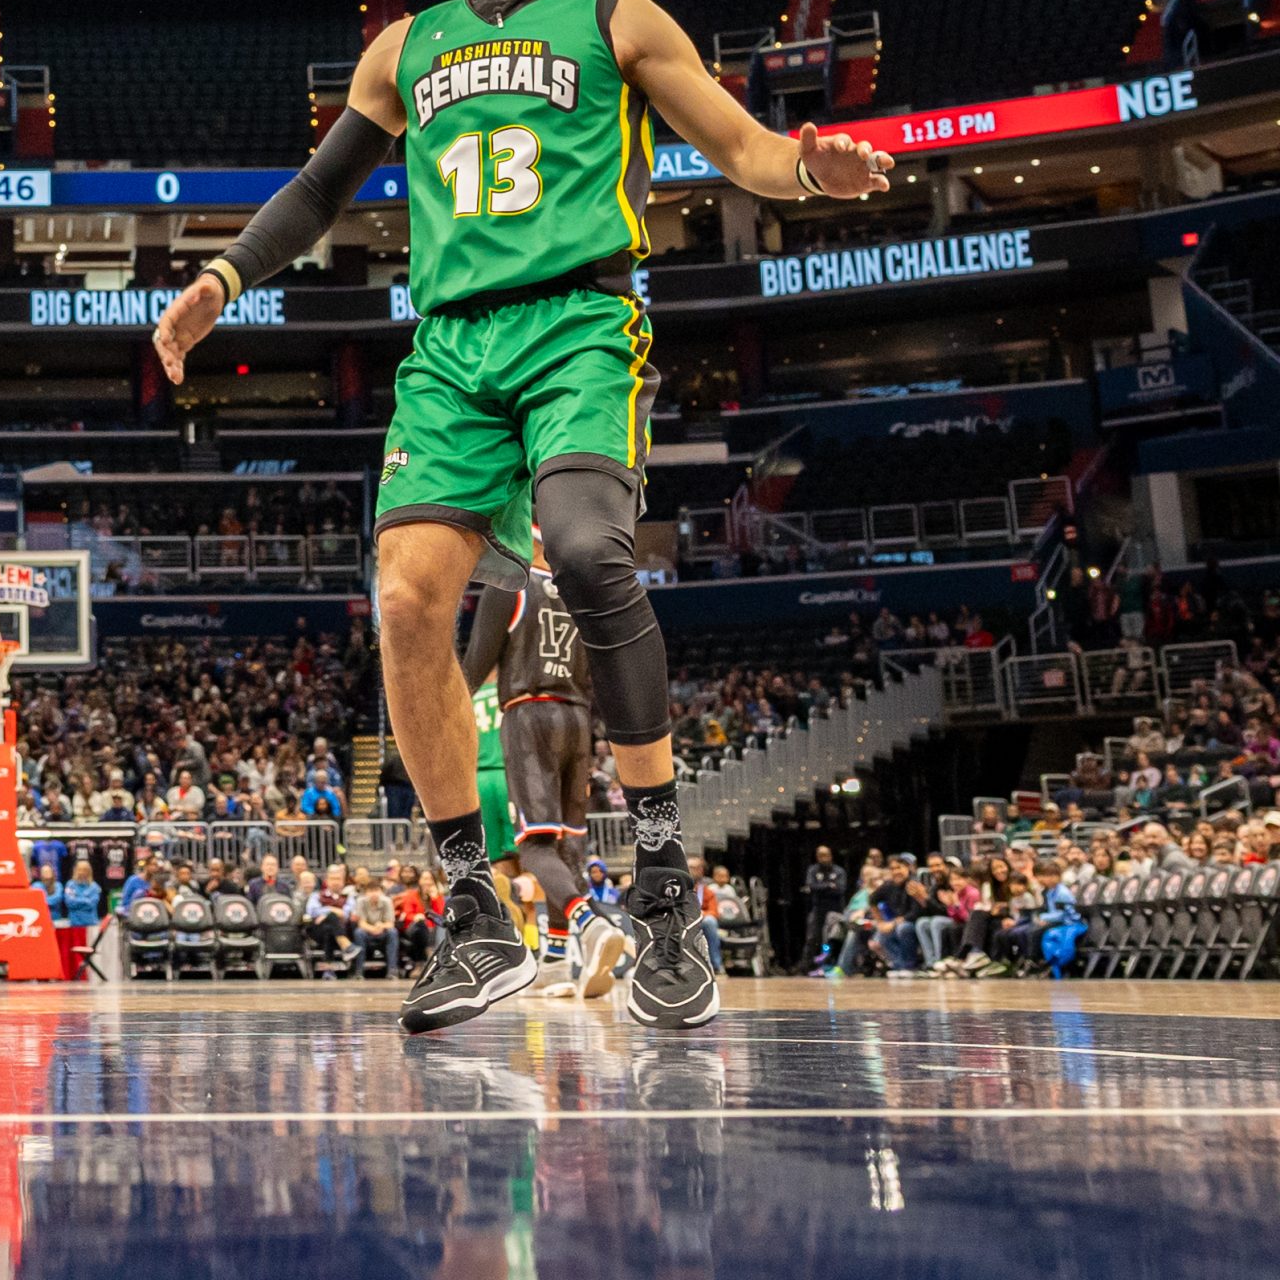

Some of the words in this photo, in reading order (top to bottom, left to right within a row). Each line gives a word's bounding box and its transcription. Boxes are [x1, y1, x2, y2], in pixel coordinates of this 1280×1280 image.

[440, 40, 543, 69] WASHINGTON
[413, 56, 578, 128] GENERALS
[1118, 71, 1198, 122] NGE
[901, 116, 953, 144] 1:18
[959, 111, 996, 136] PM
[156, 172, 181, 203] 0
[384, 179, 398, 197] 0
[436, 124, 543, 219] 13
[760, 259, 803, 297] BIG
[806, 249, 884, 292] CHAIN
[886, 229, 1034, 283] CHALLENGE
[30, 290, 72, 326] BIG
[74, 290, 147, 325] CHAIN
[537, 607, 579, 662] 17
